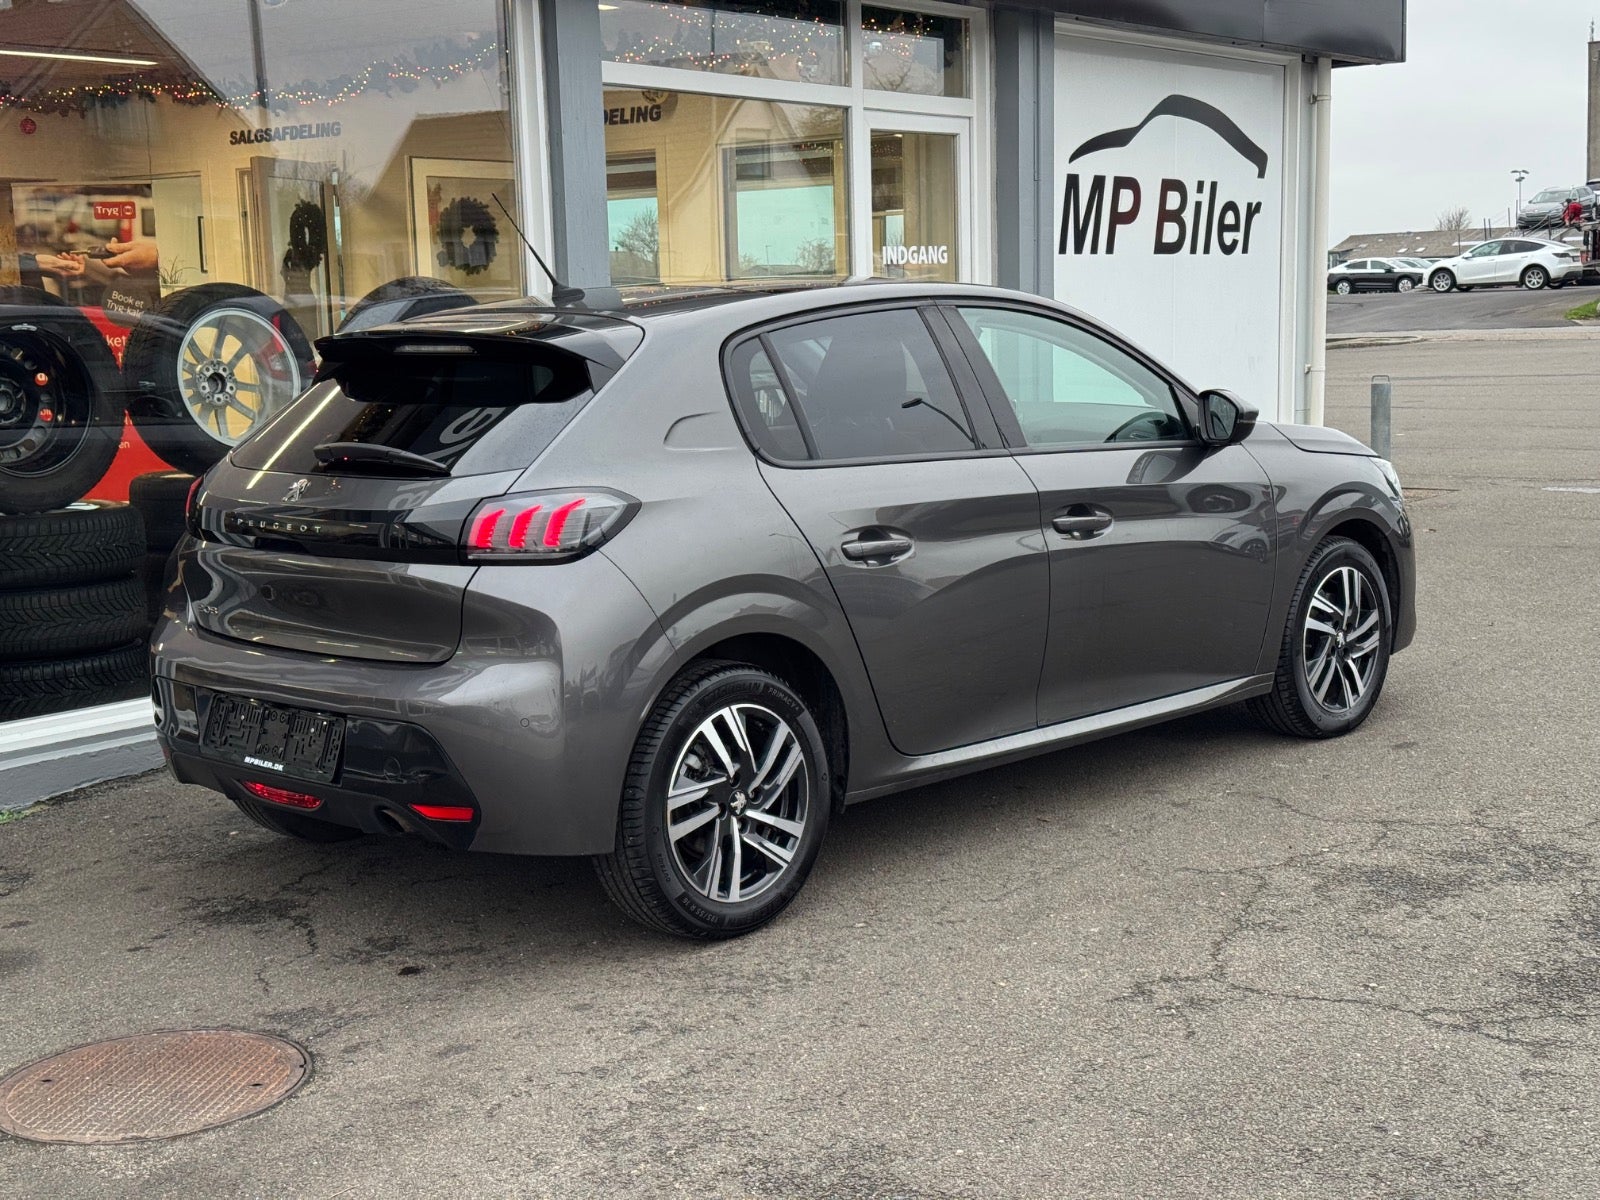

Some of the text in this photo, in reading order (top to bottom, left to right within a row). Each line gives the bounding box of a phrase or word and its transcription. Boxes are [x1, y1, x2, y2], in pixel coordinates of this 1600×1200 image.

[229, 121, 343, 145] SALGSAFDELING
[95, 205, 120, 217] Tryg
[1058, 173, 1262, 256] MP Biler
[882, 245, 948, 265] INDGANG
[112, 290, 145, 309] Book et
[237, 517, 322, 534] PEUGEOT
